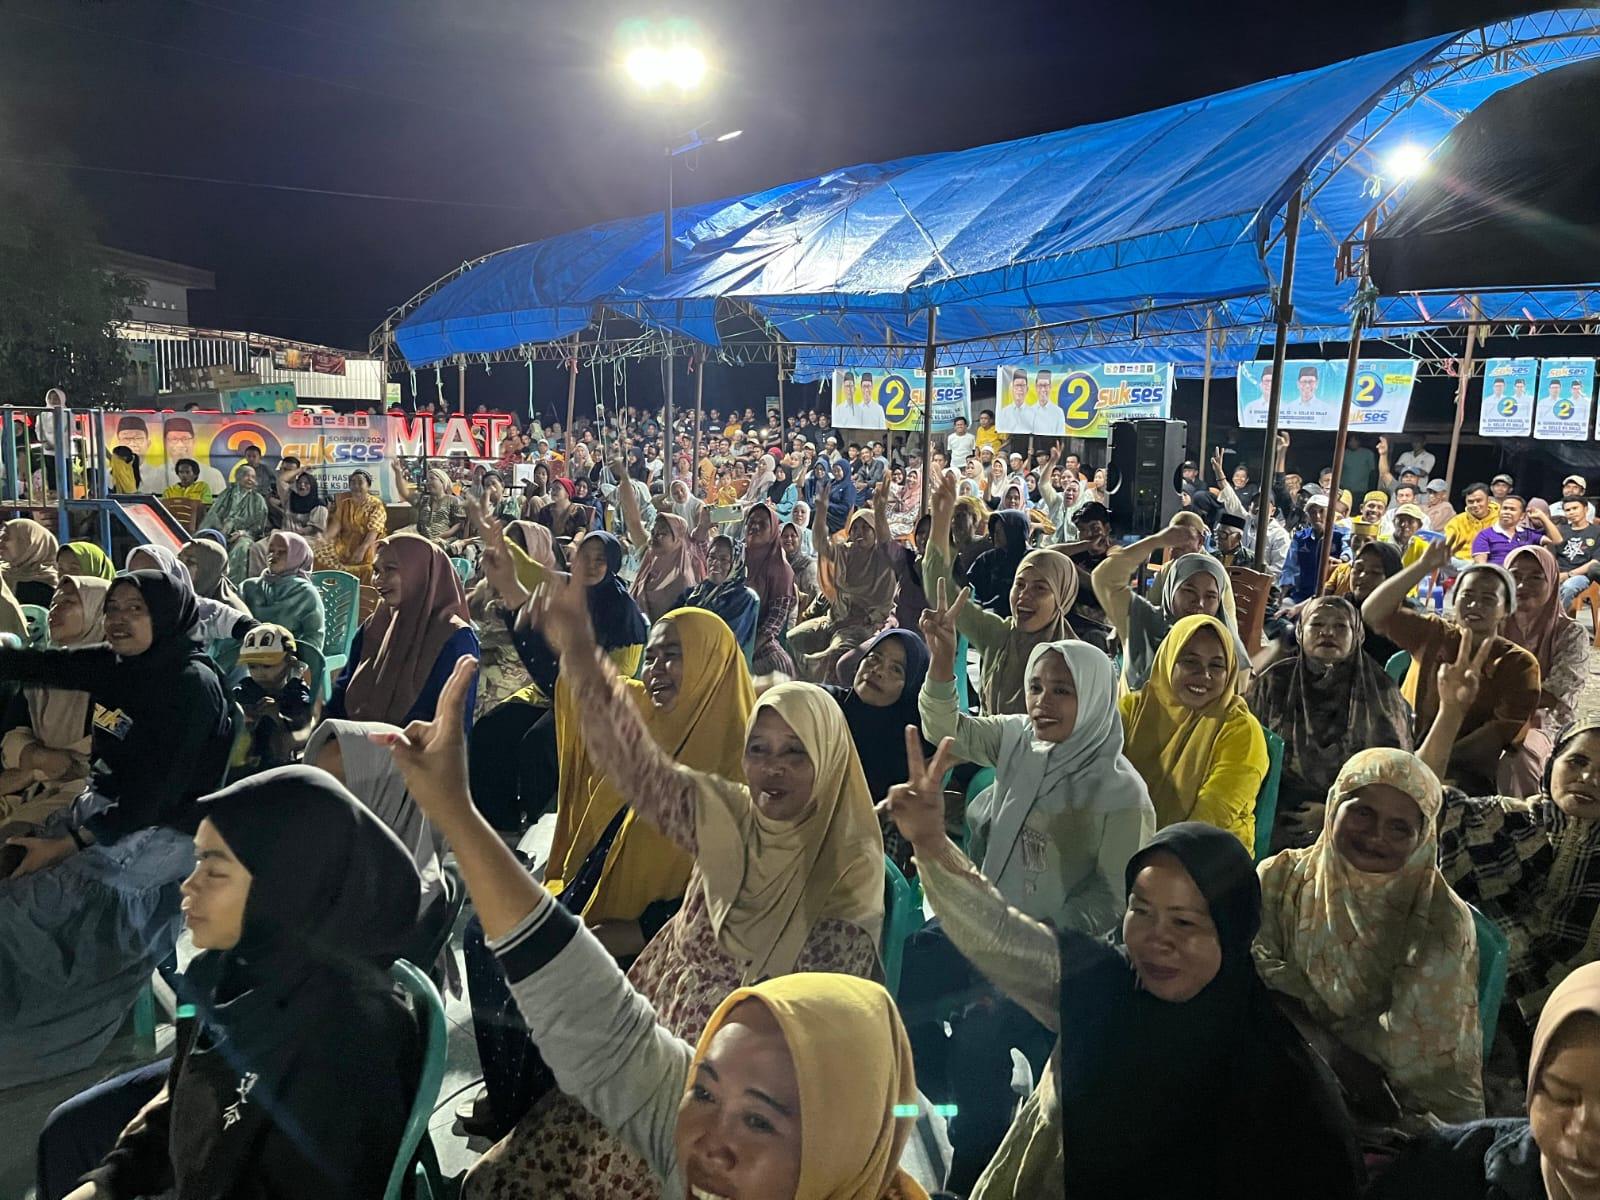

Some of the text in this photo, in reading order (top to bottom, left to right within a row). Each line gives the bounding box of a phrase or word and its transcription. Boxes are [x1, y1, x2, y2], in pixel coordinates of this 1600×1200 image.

[886, 380, 904, 416] 2
[1067, 378, 1090, 419] 2
[1096, 380, 1163, 407] sukses
[1356, 376, 1375, 401] 2
[1503, 399, 1513, 414] 2
[1558, 402, 1570, 417] 2
[281, 434, 385, 465] sukses
[367, 436, 386, 444] 2024
